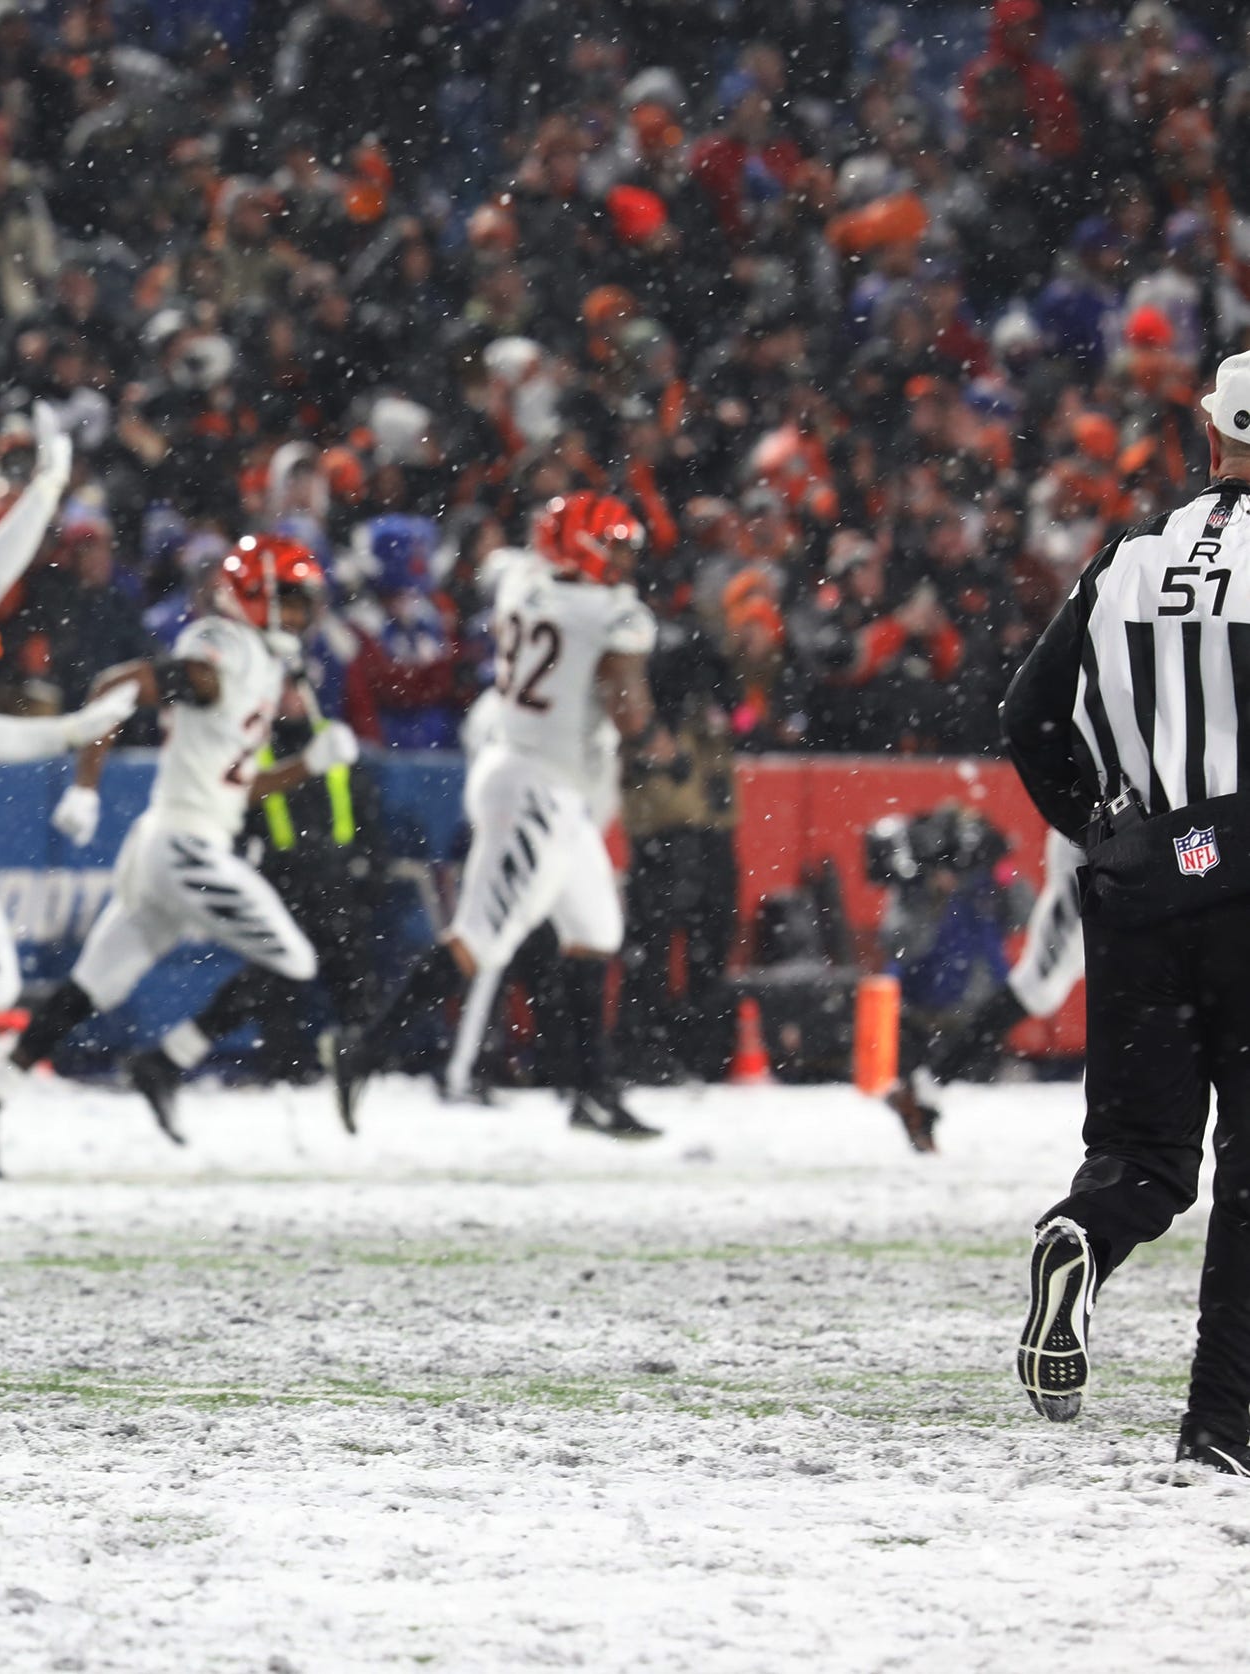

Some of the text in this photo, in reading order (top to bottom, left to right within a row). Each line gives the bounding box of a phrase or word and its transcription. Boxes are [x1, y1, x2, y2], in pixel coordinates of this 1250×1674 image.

[1188, 541, 1221, 563] R
[1158, 566, 1232, 616] 51
[1182, 846, 1216, 870] NFL
